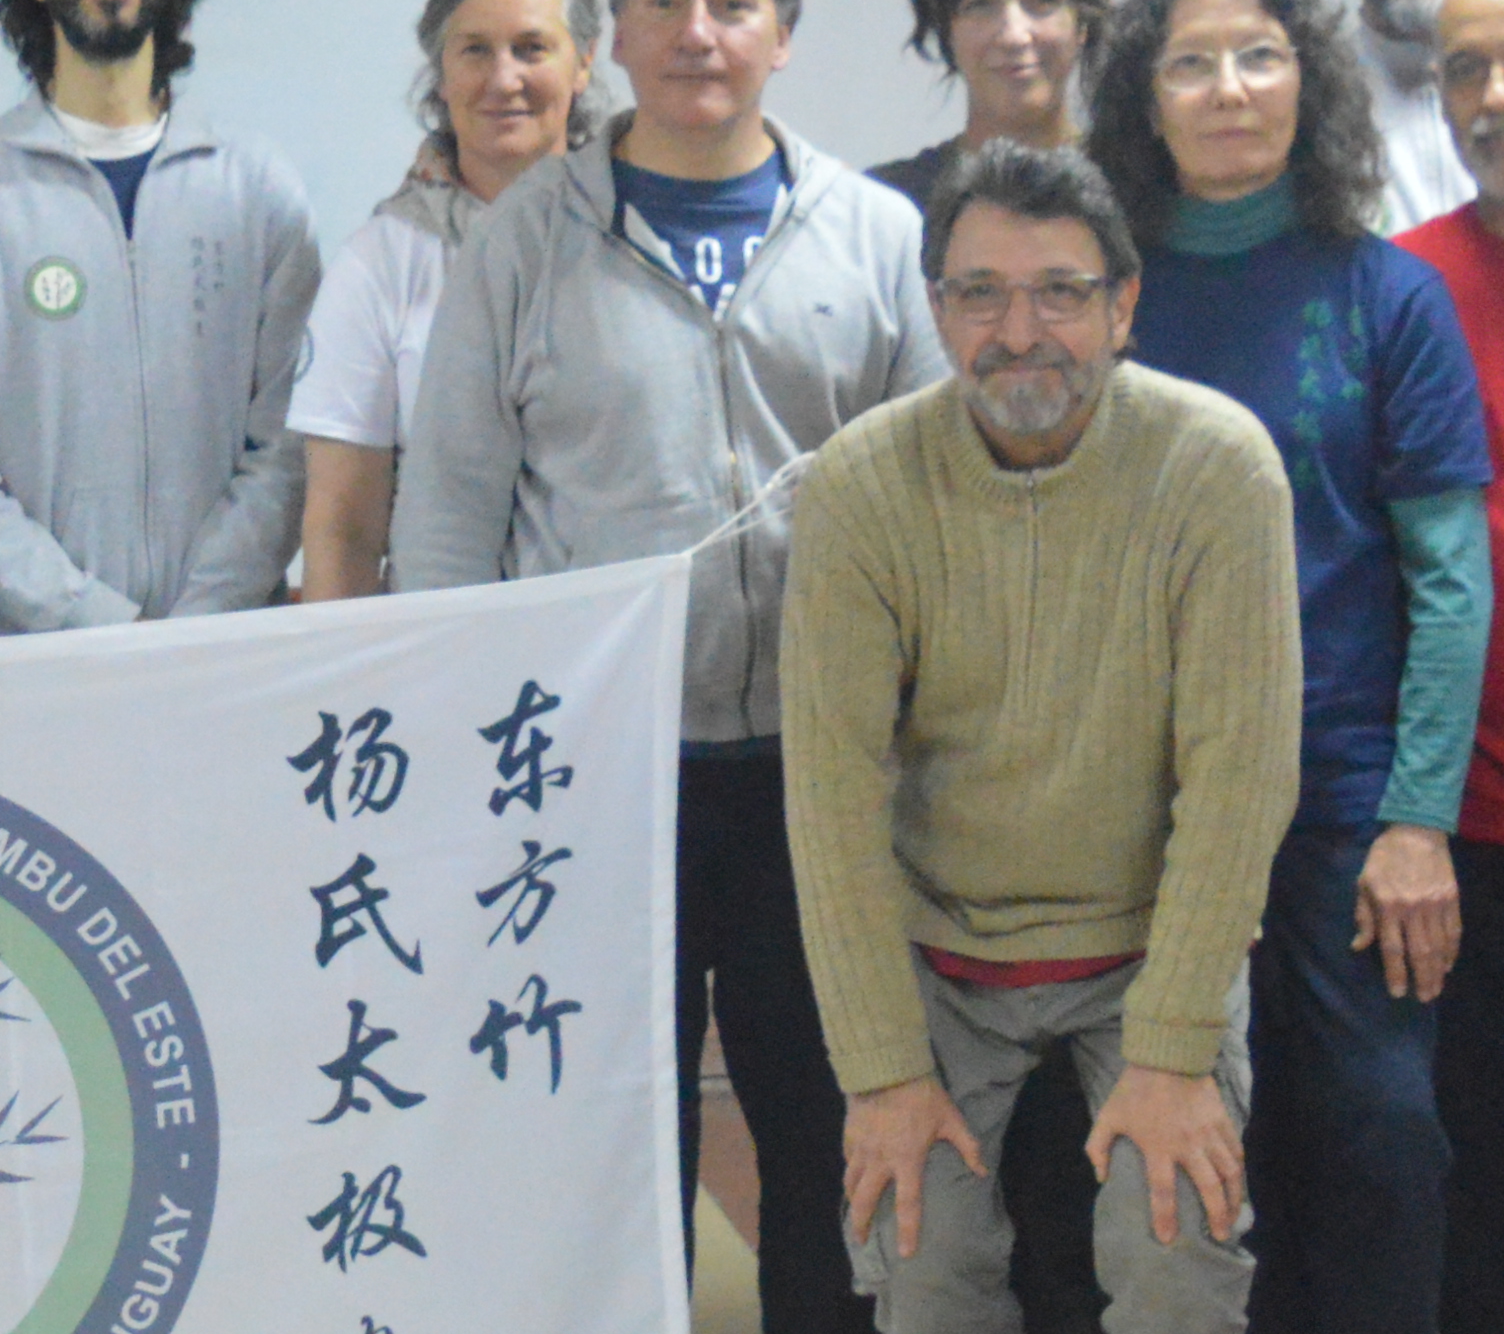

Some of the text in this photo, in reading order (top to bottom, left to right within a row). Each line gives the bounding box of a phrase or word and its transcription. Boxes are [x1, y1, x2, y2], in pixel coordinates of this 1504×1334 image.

[76, 910, 150, 1001] DEL
[132, 1001, 197, 1130] ESTE
[469, 679, 583, 1096] 东方竹
